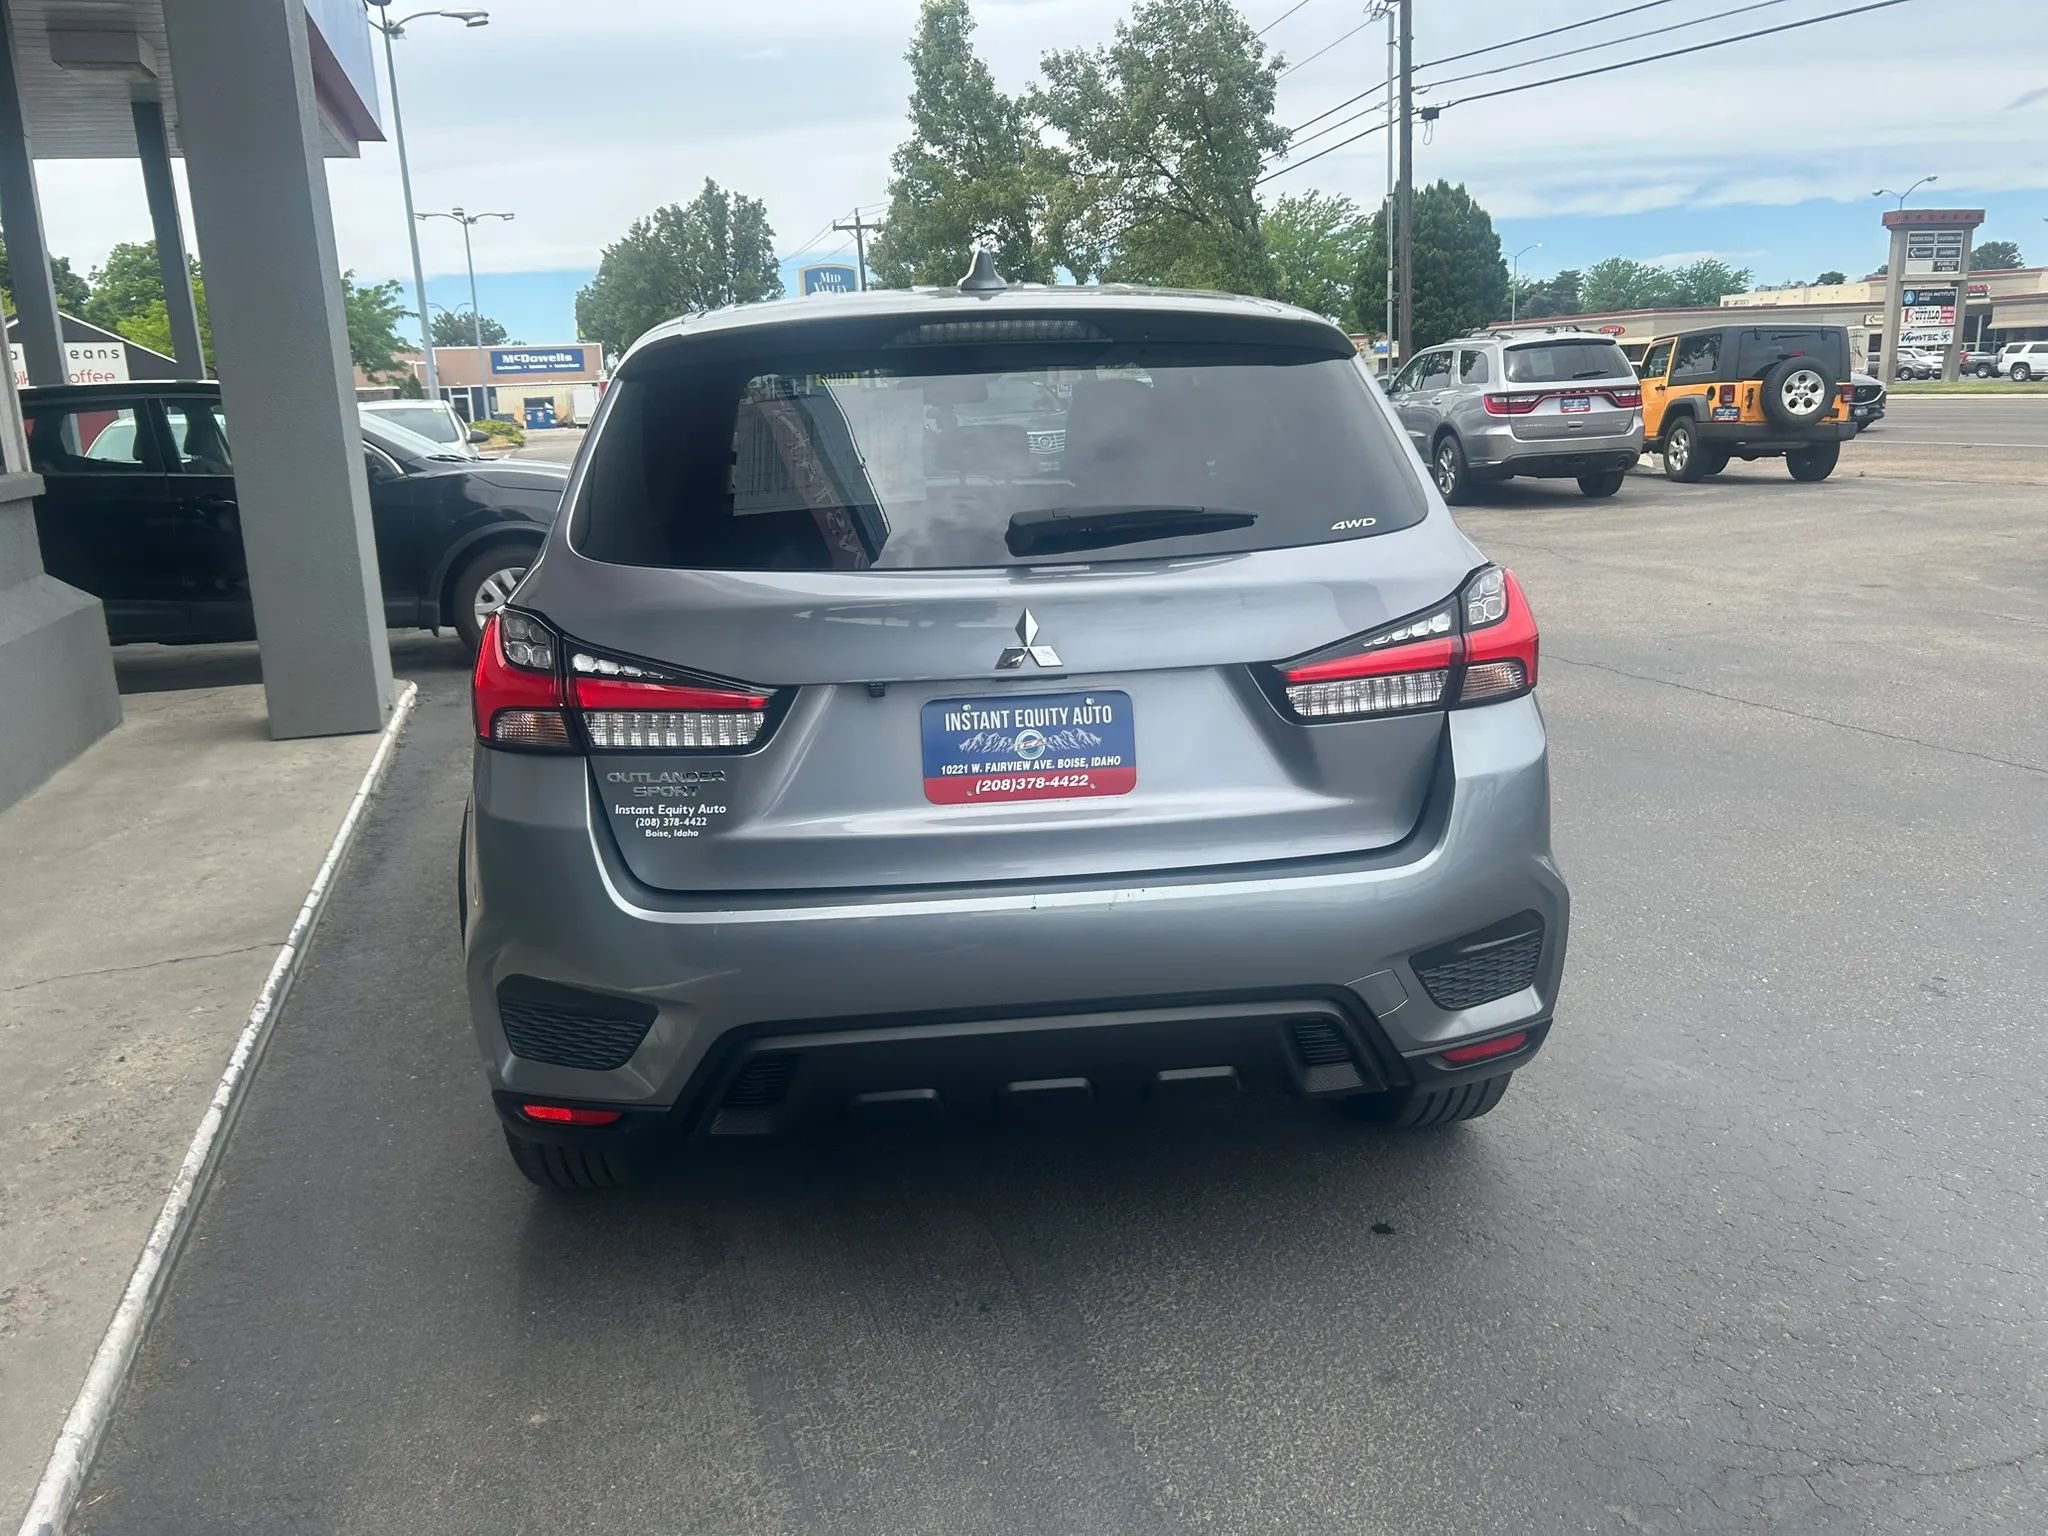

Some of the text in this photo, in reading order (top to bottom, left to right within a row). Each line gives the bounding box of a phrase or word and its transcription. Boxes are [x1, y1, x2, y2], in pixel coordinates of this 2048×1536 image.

[820, 271, 841, 283] MID
[69, 349, 120, 360] eans
[69, 369, 115, 384] offee
[1331, 517, 1376, 530] 4WD
[945, 705, 1113, 732] INSTANT EQUITY AUTO
[941, 755, 1121, 776] 10221 W. FAIRVIEW AVE. BOISE, IDAHO
[606, 770, 727, 784] OUTLANDER
[975, 774, 1089, 795] (208)378-4422
[633, 786, 700, 797] SPORT
[615, 803, 727, 817] Instant Equity Auto
[635, 817, 707, 829] (208) 378-4422
[645, 829, 699, 838] Boise, Idaho
